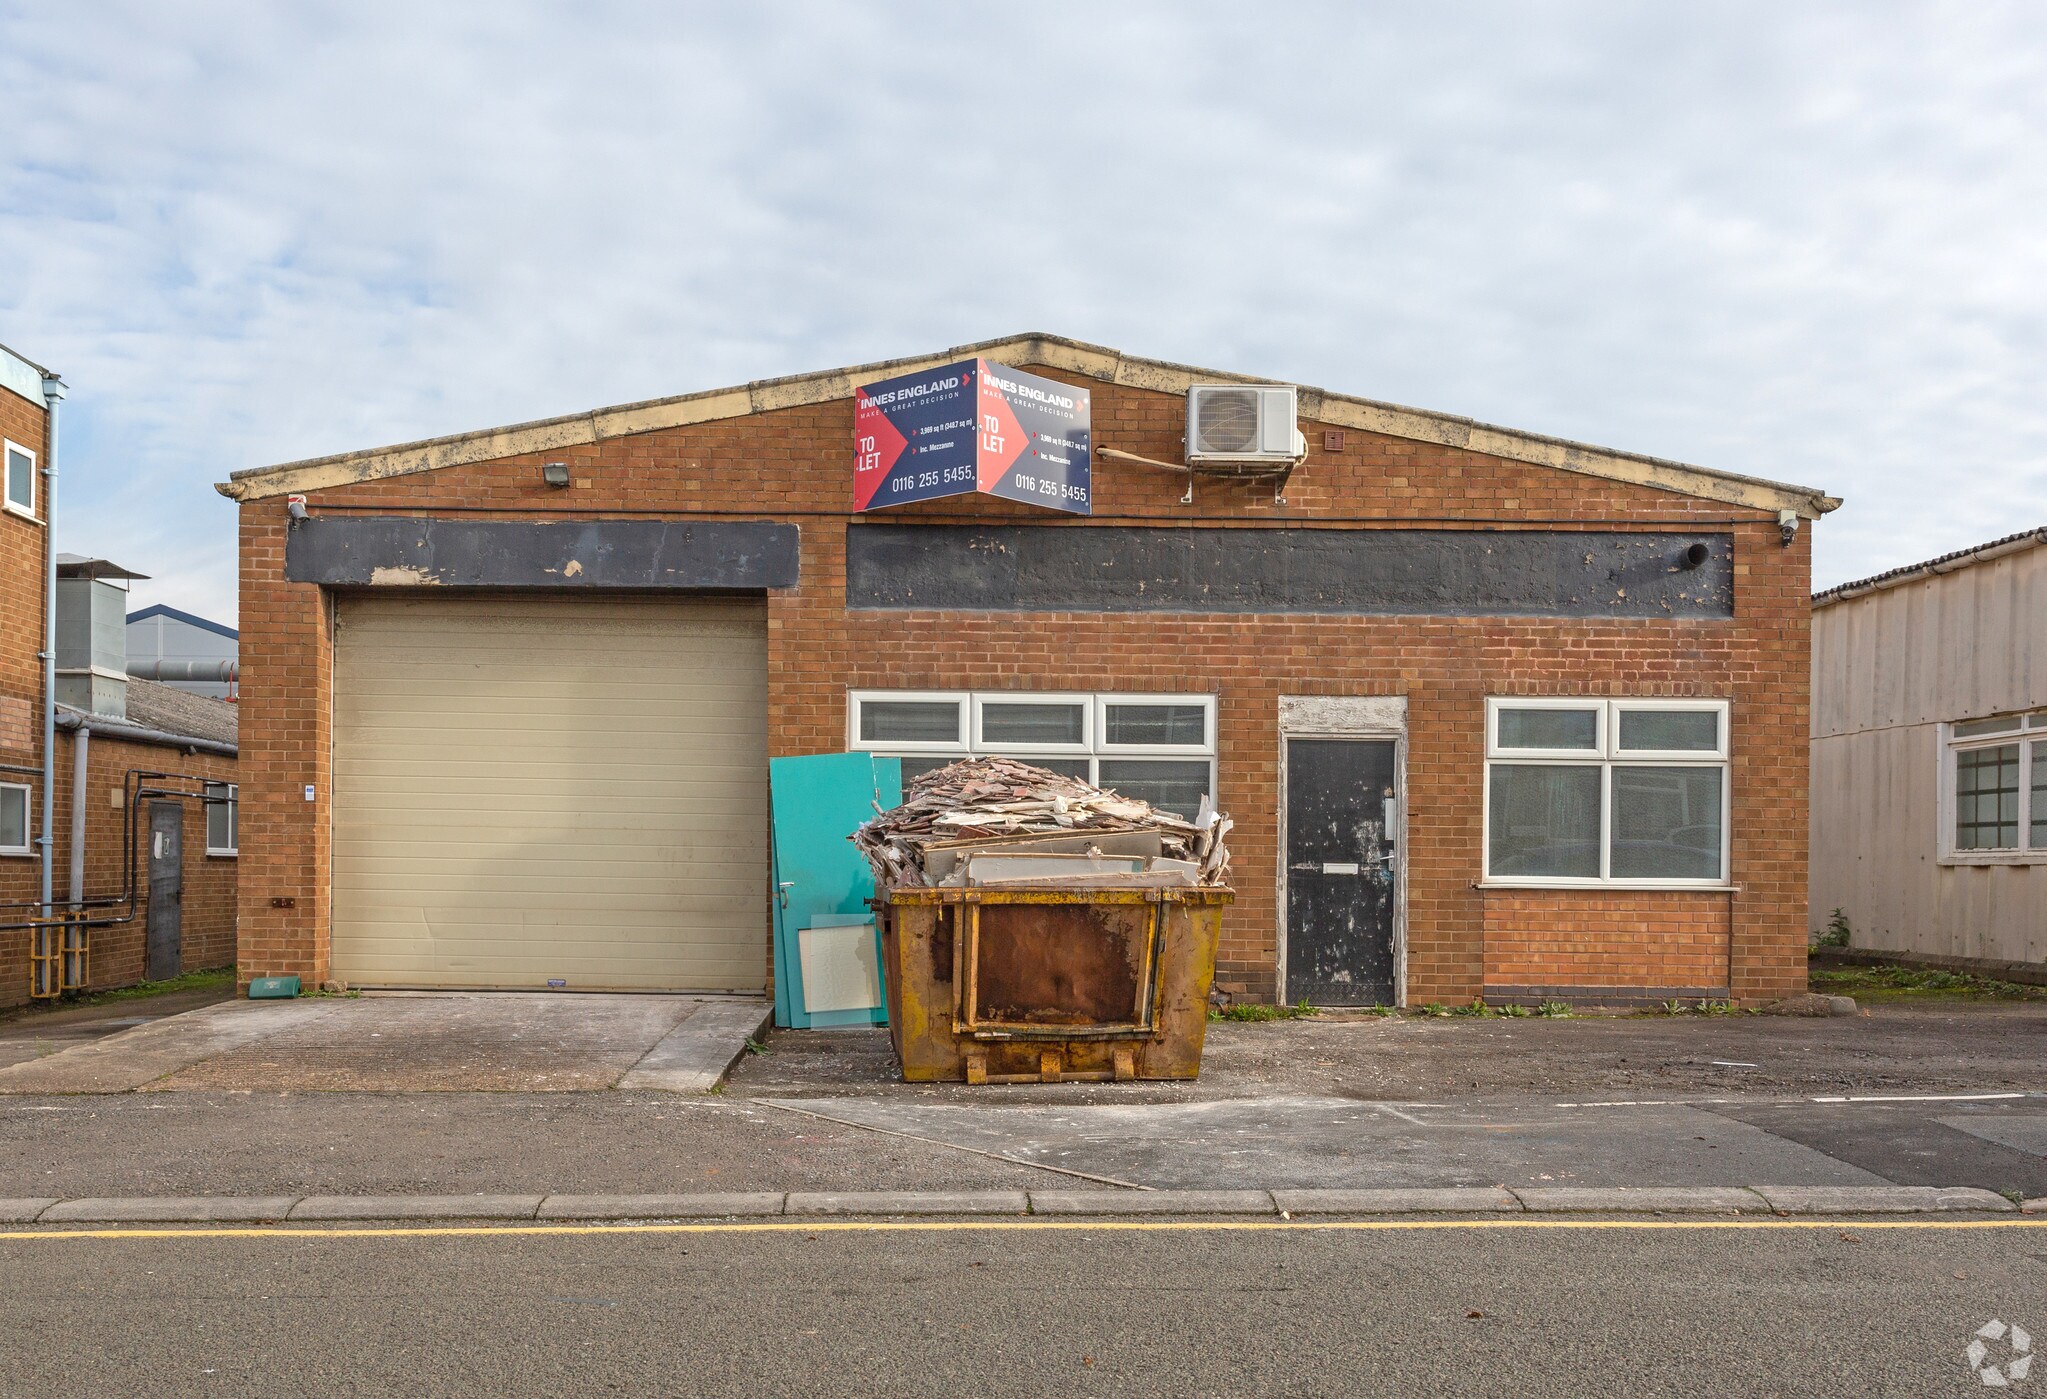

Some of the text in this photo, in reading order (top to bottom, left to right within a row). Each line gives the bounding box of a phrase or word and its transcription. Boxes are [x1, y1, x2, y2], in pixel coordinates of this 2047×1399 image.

[861, 377, 959, 410] INNES ENGLAND
[983, 373, 1074, 409] INNES ENGLAND
[860, 409, 880, 419] MAKE
[892, 401, 916, 412] GREAT
[920, 391, 960, 406] DECISION
[983, 389, 1002, 400] MAKE
[1013, 398, 1036, 409] GREAT
[1039, 405, 1074, 420] DECISION
[933, 425, 940, 433] sq
[959, 420, 966, 428] sq
[983, 414, 999, 434] TO
[860, 436, 875, 453] TO
[920, 441, 954, 454] Inc. Mezzanine
[983, 433, 1005, 454] LET
[859, 452, 881, 472] LET
[1049, 454, 1071, 466] Mezzanine
[892, 465, 972, 492] 0116 255 5455
[1015, 473, 1087, 502] 0116 255 5455
